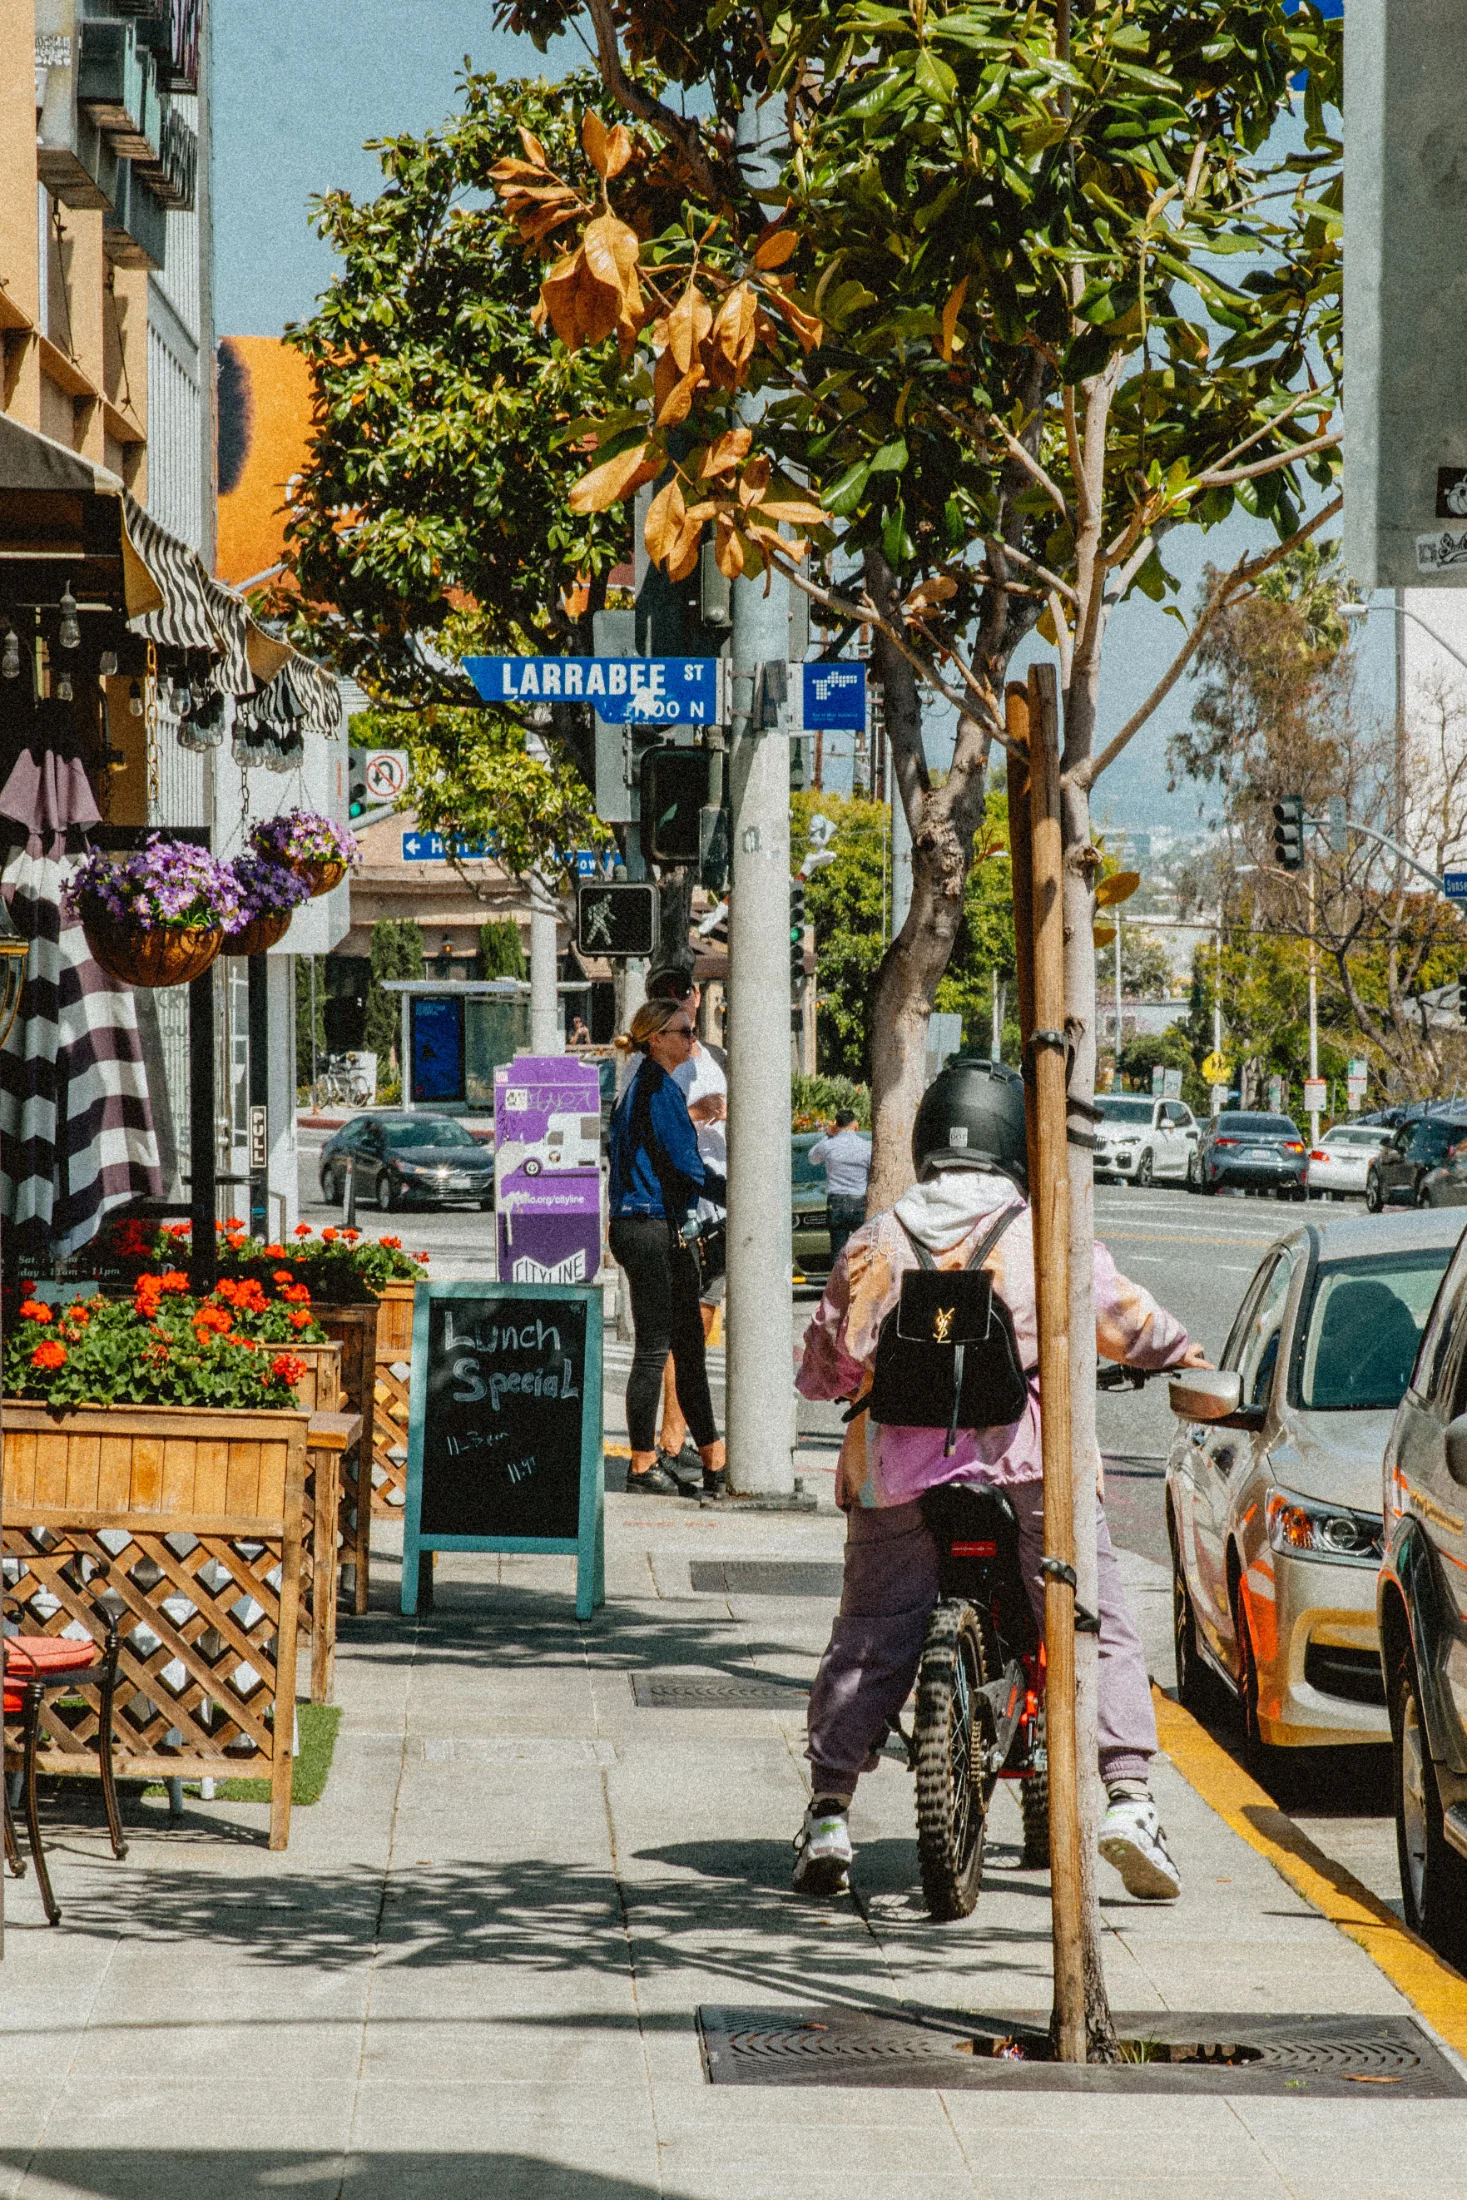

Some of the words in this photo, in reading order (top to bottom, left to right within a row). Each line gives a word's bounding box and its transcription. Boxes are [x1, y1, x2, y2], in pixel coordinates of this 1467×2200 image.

[503, 663, 666, 695] LARRABEE
[684, 664, 704, 681] ST
[690, 701, 704, 718] N
[253, 1112, 264, 1163] PULL
[515, 1253, 584, 1283] CITYLINE
[444, 1311, 561, 1353] Lunch
